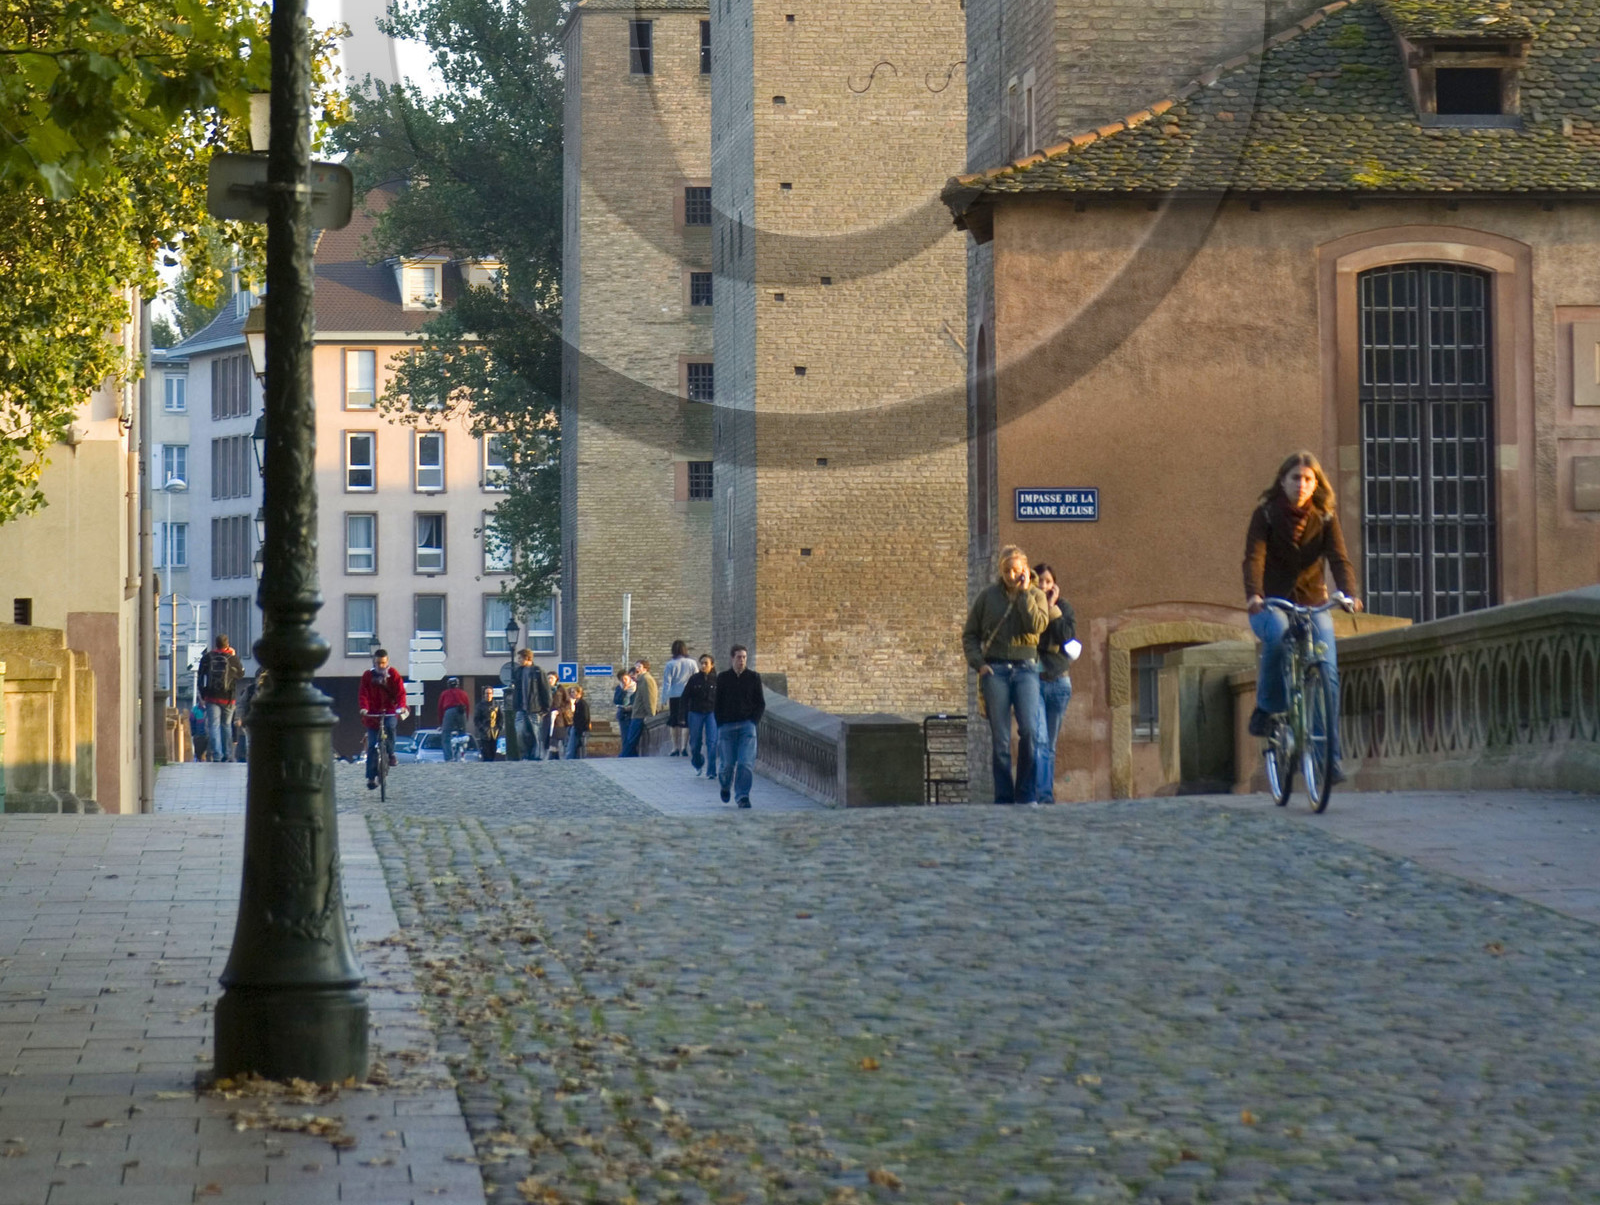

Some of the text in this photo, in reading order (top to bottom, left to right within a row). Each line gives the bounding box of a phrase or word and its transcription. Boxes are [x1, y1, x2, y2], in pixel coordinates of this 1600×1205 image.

[1020, 494, 1094, 503] IMPASSE DE LA
[1020, 504, 1095, 515] GRANDE ÉCLUSE
[562, 667, 572, 680] P
